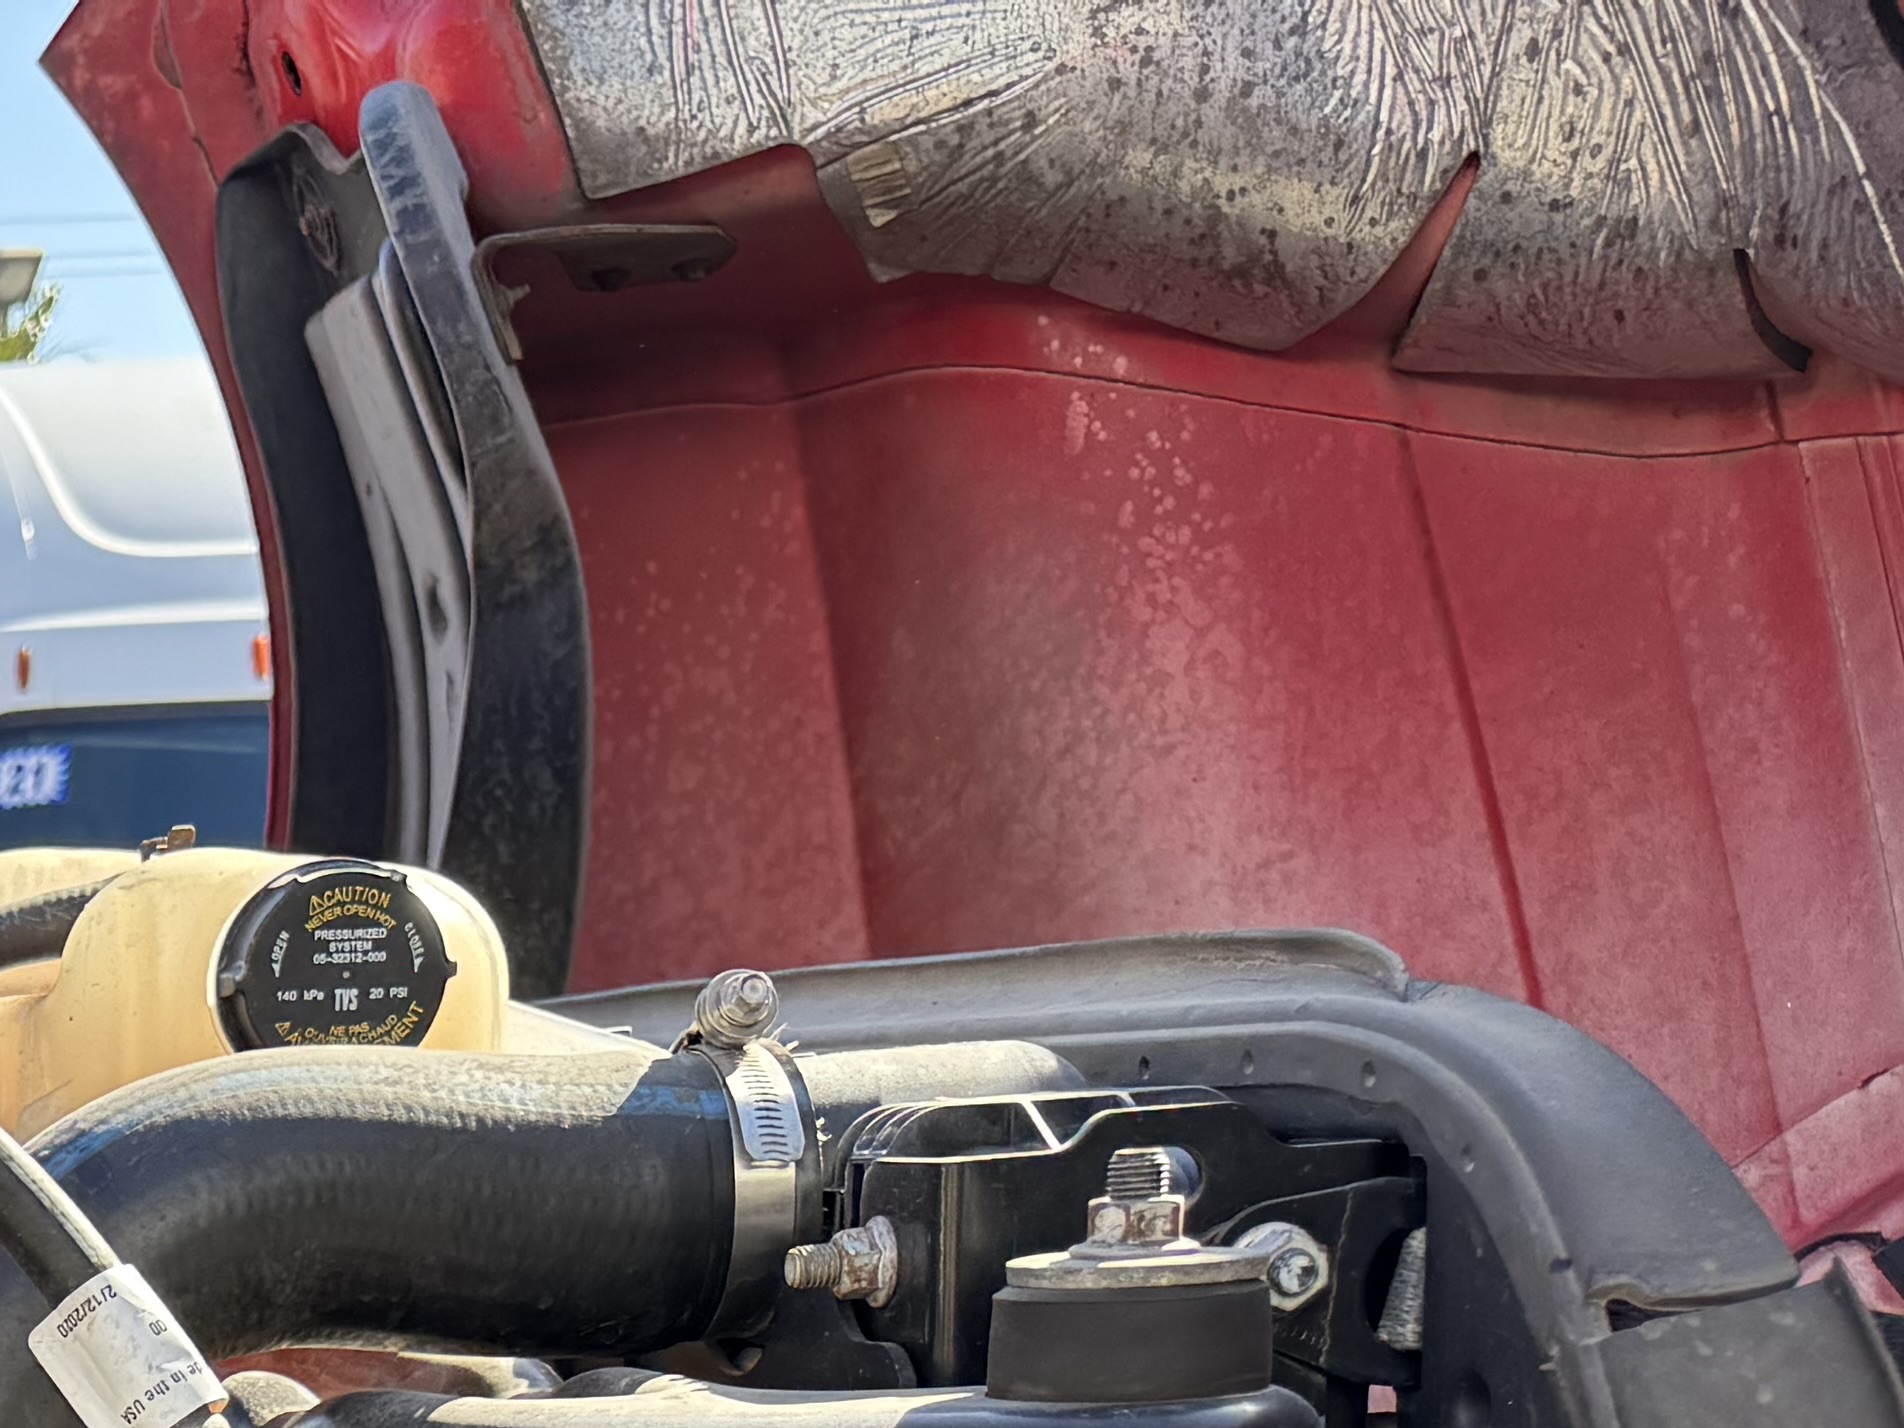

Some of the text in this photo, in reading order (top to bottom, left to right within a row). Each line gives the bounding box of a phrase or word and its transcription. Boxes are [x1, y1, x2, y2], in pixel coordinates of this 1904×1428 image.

[324, 886, 392, 908] CAUTION
[305, 907, 343, 932] NEVER
[374, 909, 397, 930] HOT
[270, 930, 290, 961] OPEN
[314, 928, 387, 941] PRESSURIZED
[329, 942, 372, 952] SYSTEM
[276, 991, 297, 1002] 140
[334, 988, 359, 1012] TVS
[369, 988, 384, 1000] 20
[389, 987, 408, 998] PSI
[145, 1380, 170, 1402] the
[120, 1399, 146, 1425] USA
